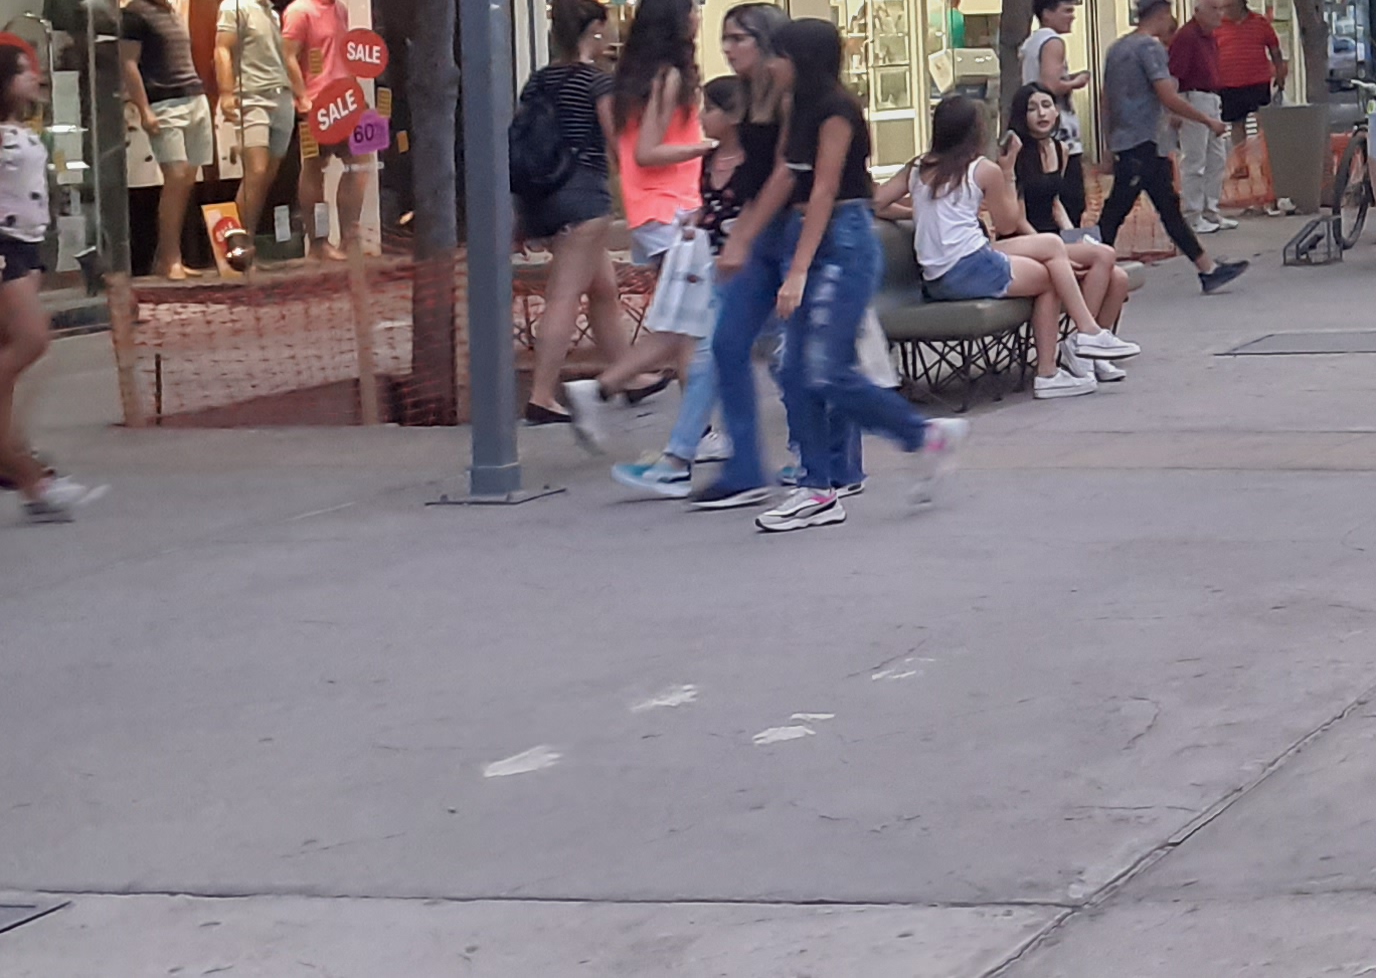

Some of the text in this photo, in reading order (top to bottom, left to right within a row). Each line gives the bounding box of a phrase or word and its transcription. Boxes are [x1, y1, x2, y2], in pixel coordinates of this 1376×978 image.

[346, 41, 381, 64] SALE
[317, 89, 358, 131] SALE
[354, 123, 375, 144] 60
